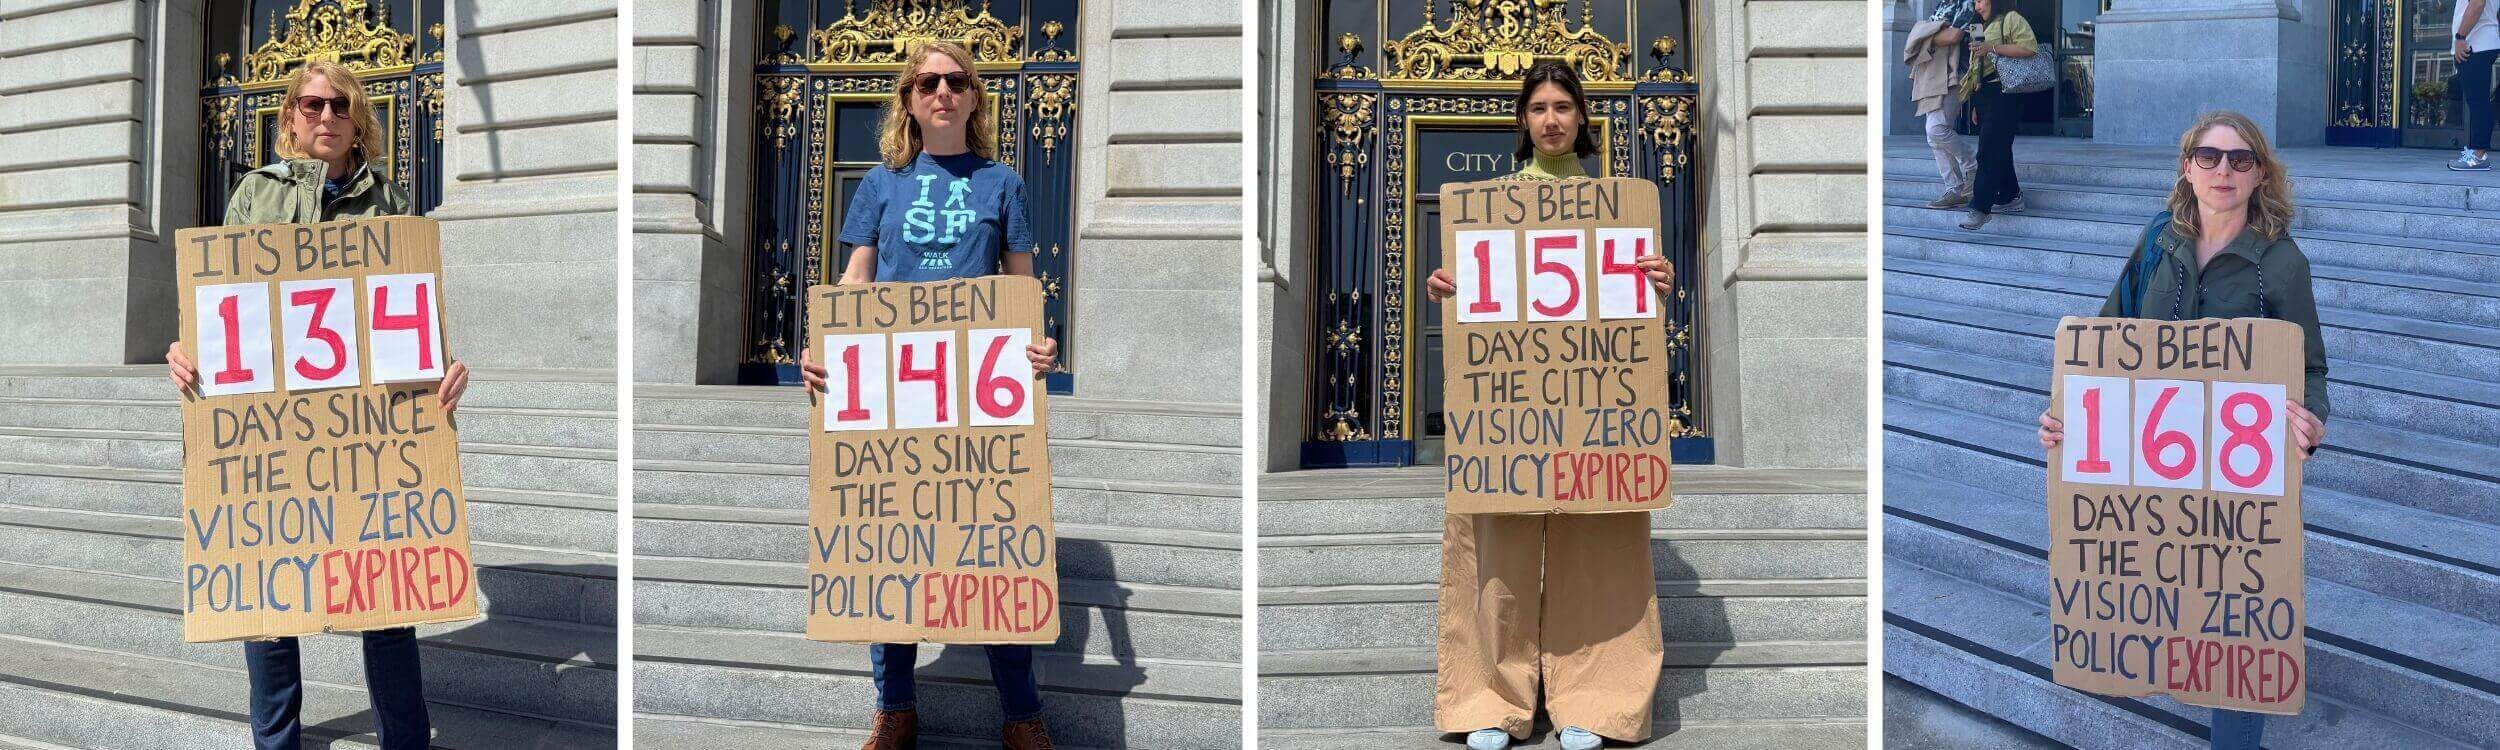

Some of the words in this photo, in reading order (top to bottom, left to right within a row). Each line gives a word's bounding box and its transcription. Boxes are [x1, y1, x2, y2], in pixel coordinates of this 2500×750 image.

[1446, 152, 1502, 171] CITY
[912, 175, 937, 207] I
[1453, 185, 1526, 224] IT'S
[1537, 181, 1619, 222] BEEN
[192, 229, 281, 277] IT'S
[294, 221, 391, 272] BEEN
[903, 207, 976, 244] SF
[1470, 236, 1647, 316] 154
[822, 287, 897, 328] IT'S
[910, 280, 996, 325] BEEN
[215, 283, 434, 385] 134
[1468, 328, 1550, 365] DAYS
[1560, 326, 1648, 363] SINCE
[2065, 323, 2142, 370] IT'S
[2157, 322, 2253, 371] BEEN
[838, 335, 1025, 422] 146
[1464, 370, 1530, 403] THE
[1542, 366, 1637, 407] CITY'S
[212, 398, 316, 449] DAYS
[327, 389, 435, 438] SINCE
[1449, 408, 1564, 446] VISION
[1582, 408, 1662, 447] ZERO
[2076, 387, 2273, 488] 168
[208, 450, 291, 496] THE
[306, 439, 422, 492] CITY'S
[835, 436, 921, 477] DAYS
[932, 434, 1030, 474] SINCE
[1448, 453, 1550, 498] POLICY
[1554, 451, 1668, 502] EXPIRED
[190, 496, 334, 550] VISION
[359, 488, 456, 542] ZERO
[830, 482, 899, 517] THE
[913, 478, 1016, 523] CITY'S
[2073, 494, 2166, 536] DAYS
[2177, 495, 2281, 544] SINCE
[813, 523, 935, 566] VISION
[956, 524, 1046, 569] ZERO
[2069, 538, 2141, 576] THE
[2156, 541, 2264, 594] CITY'S
[188, 554, 320, 613] POLICY
[323, 546, 469, 614] EXPIRED
[811, 573, 921, 624] POLICY
[924, 572, 1054, 633] EXPIRED
[2054, 578, 2180, 631] VISION
[2200, 591, 2295, 641] ZERO
[2054, 624, 2164, 684] POLICY
[2166, 636, 2299, 703] EXPIRED
